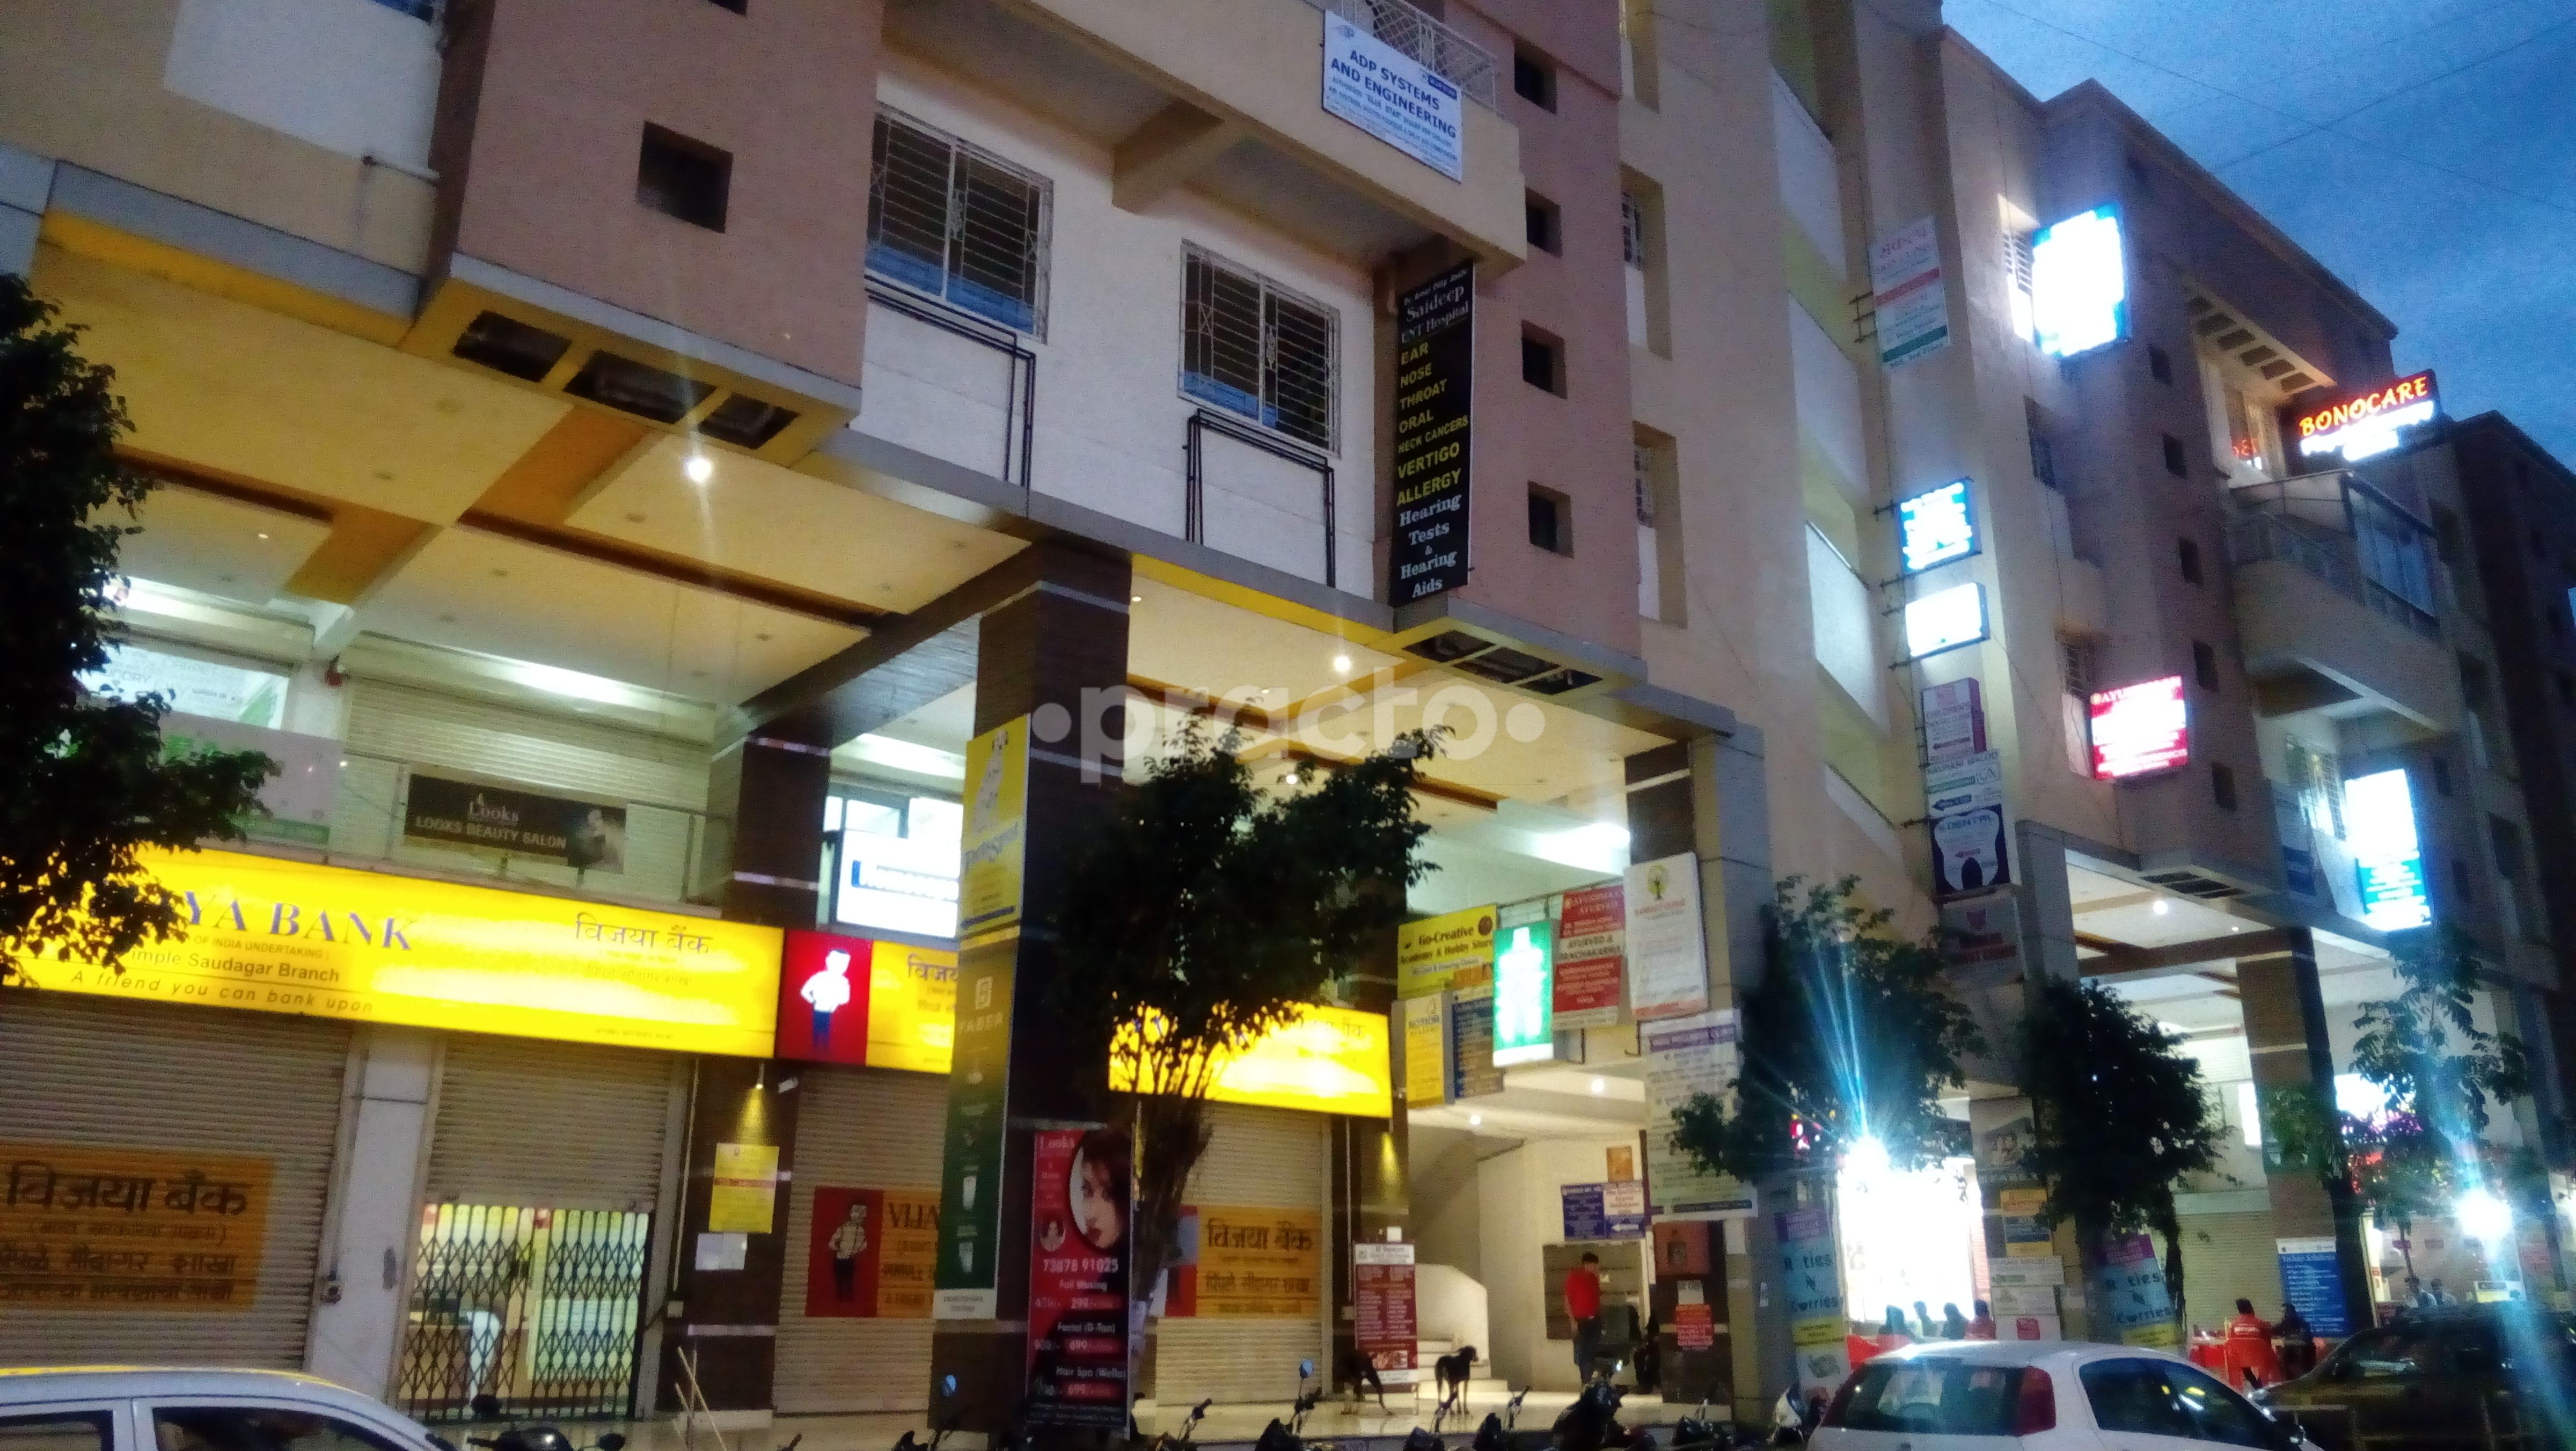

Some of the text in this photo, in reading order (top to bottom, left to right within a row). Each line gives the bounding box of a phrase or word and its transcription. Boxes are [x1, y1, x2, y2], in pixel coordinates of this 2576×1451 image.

[1350, 50, 1377, 72] ADP
[1381, 67, 1439, 111] SYSTEMS
[1331, 58, 1360, 82] AND
[1365, 77, 1457, 138] ENGINEERING
[1401, 342, 1429, 365] EAR
[1400, 362, 1432, 387] NOSE
[1400, 378, 1447, 410] THROAT
[2299, 377, 2427, 436] BONOCARE
[1399, 409, 1433, 433] ORAL
[1399, 415, 1468, 453] NECK CANCERS
[1398, 442, 1460, 479] VERTIGO
[1396, 468, 1461, 507] ALLERGY
[1399, 494, 1461, 527] Hearing
[1408, 522, 1450, 546] Tests
[1424, 545, 1432, 555] &
[1400, 551, 1458, 580] Hearing
[1412, 578, 1443, 598] Aids
[416, 816, 567, 849] LOOKS BEAUTY SALON
[268, 903, 416, 950] BANK
[575, 911, 713, 955] विजया बैंक
[130, 947, 340, 983] imple Saudagar Branch
[213, 938, 241, 950] INDIA
[245, 942, 323, 959] UNDERTAKING
[71, 970, 374, 1015] A friend you can bank upon
